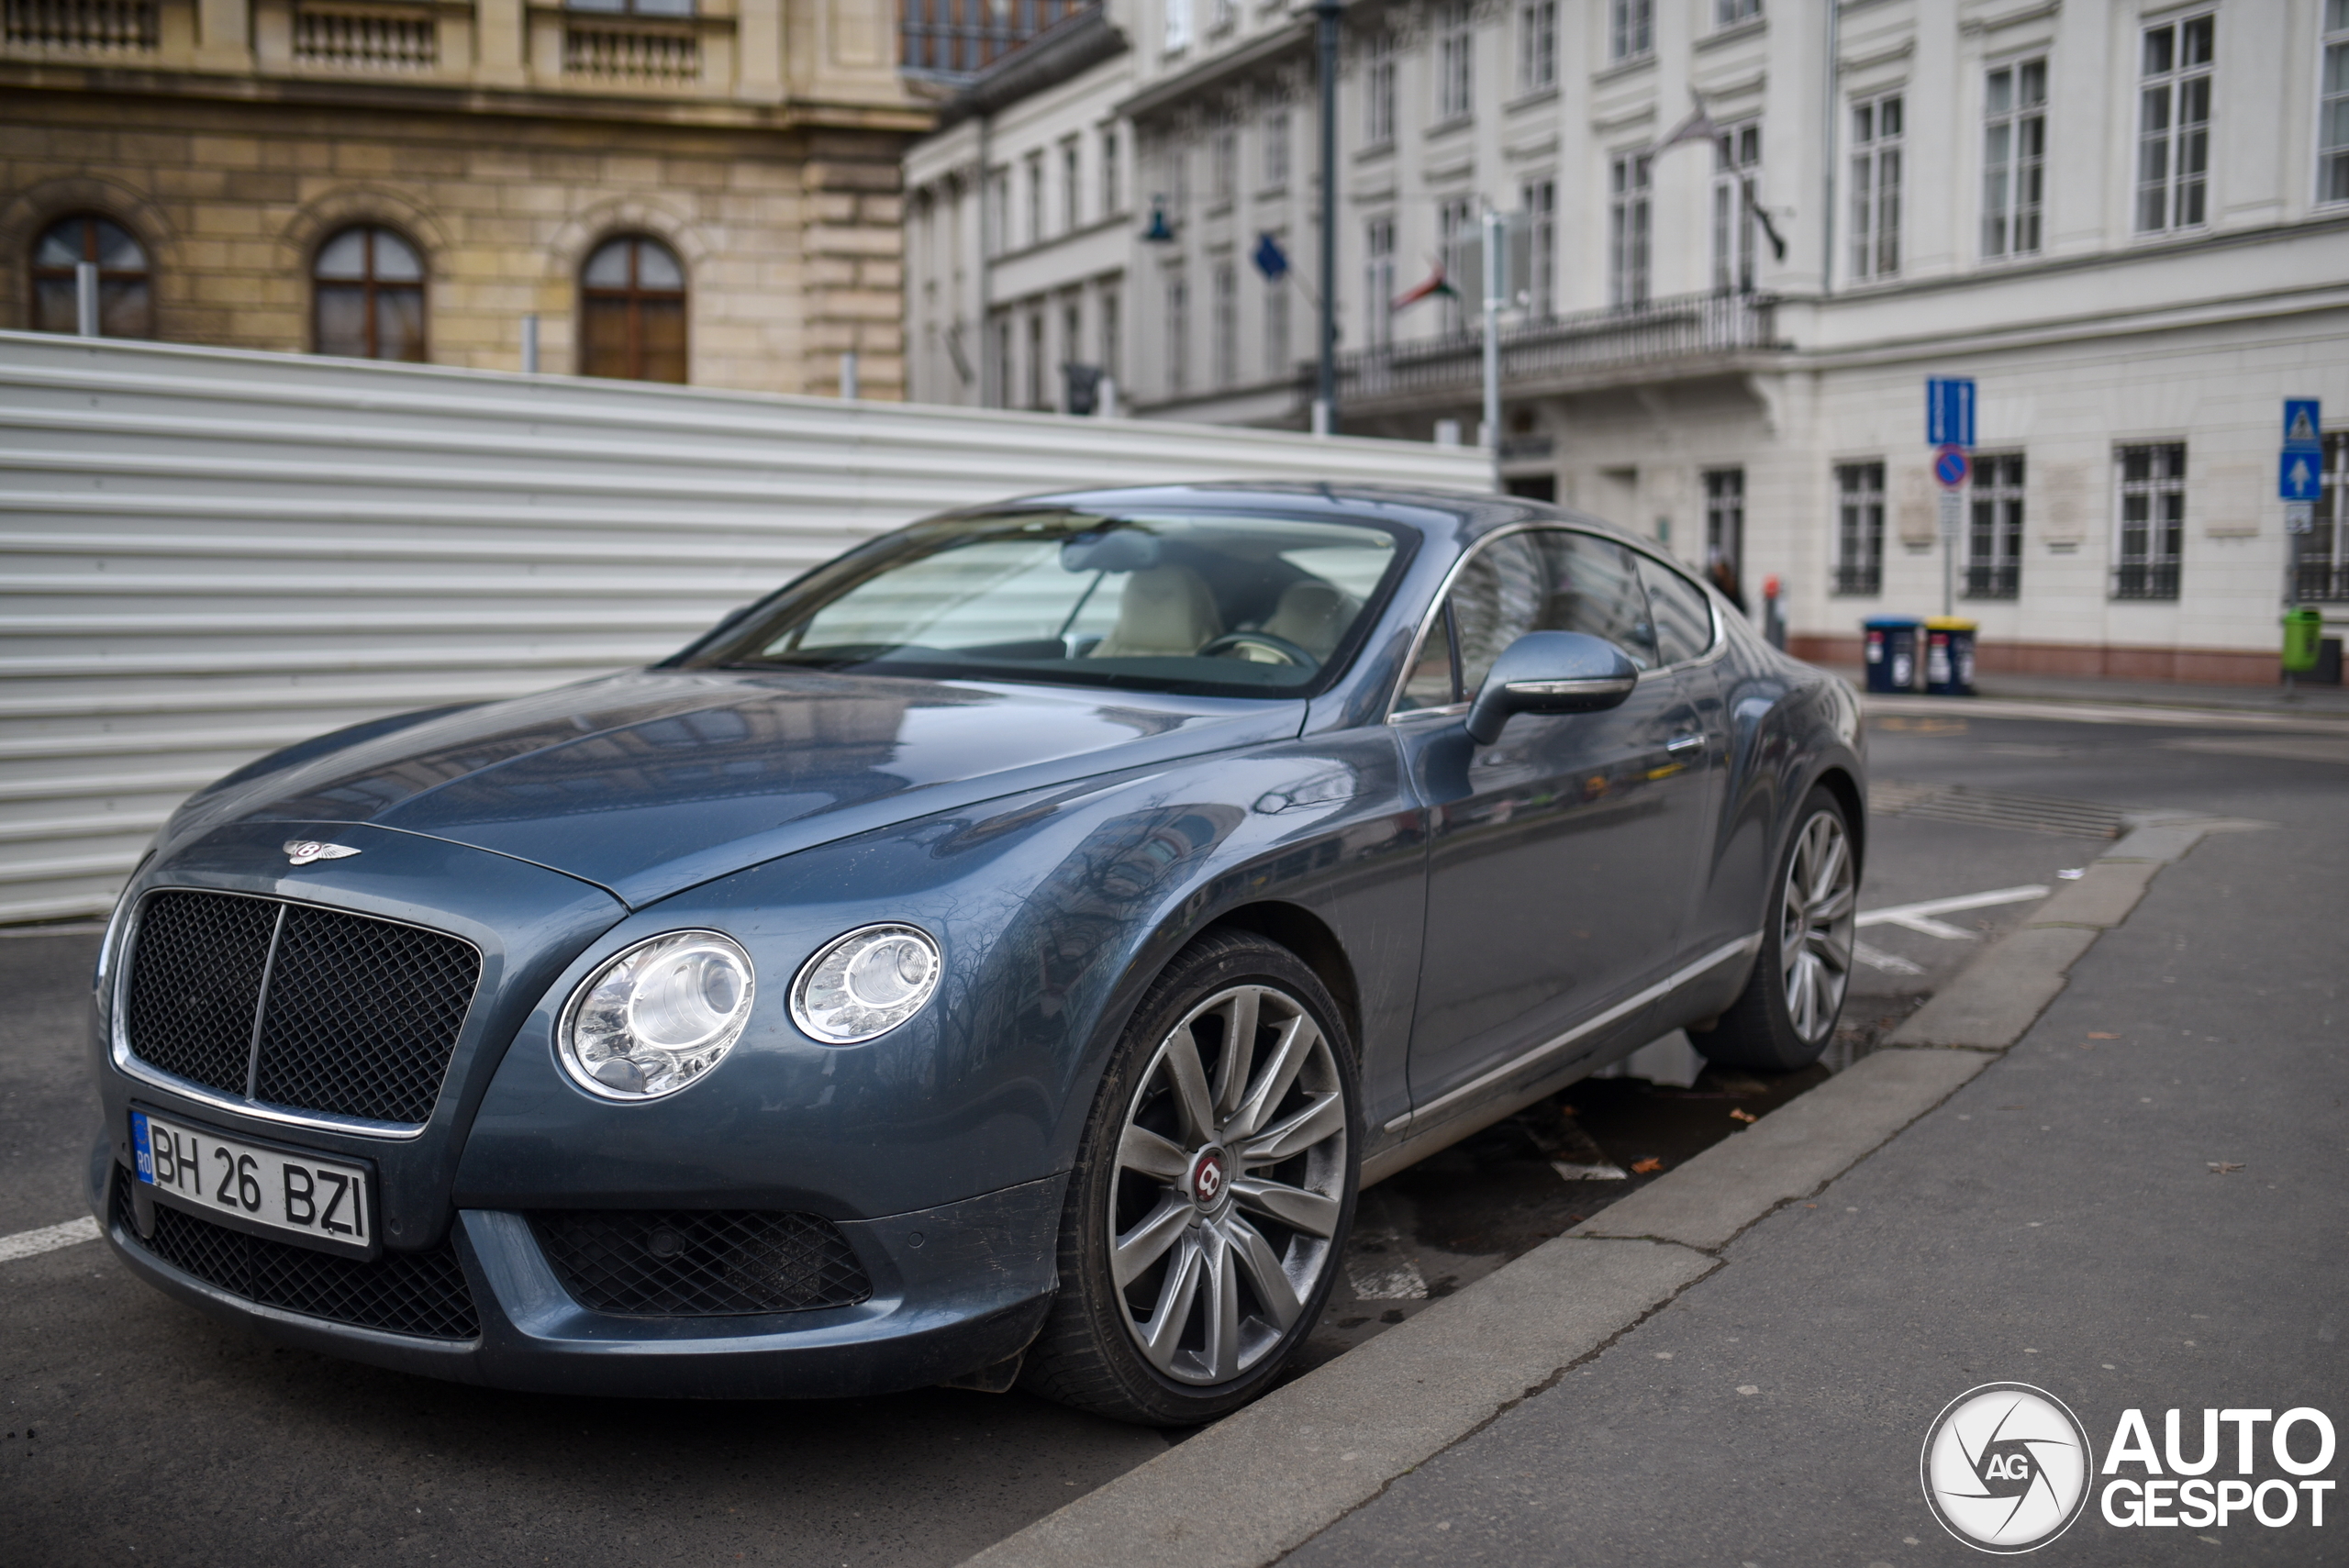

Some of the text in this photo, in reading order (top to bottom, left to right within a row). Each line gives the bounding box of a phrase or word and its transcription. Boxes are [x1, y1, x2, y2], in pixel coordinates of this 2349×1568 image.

[137, 1150, 151, 1175] RO
[1198, 1162, 1221, 1196] B
[150, 1124, 363, 1237] BH 26 BZI
